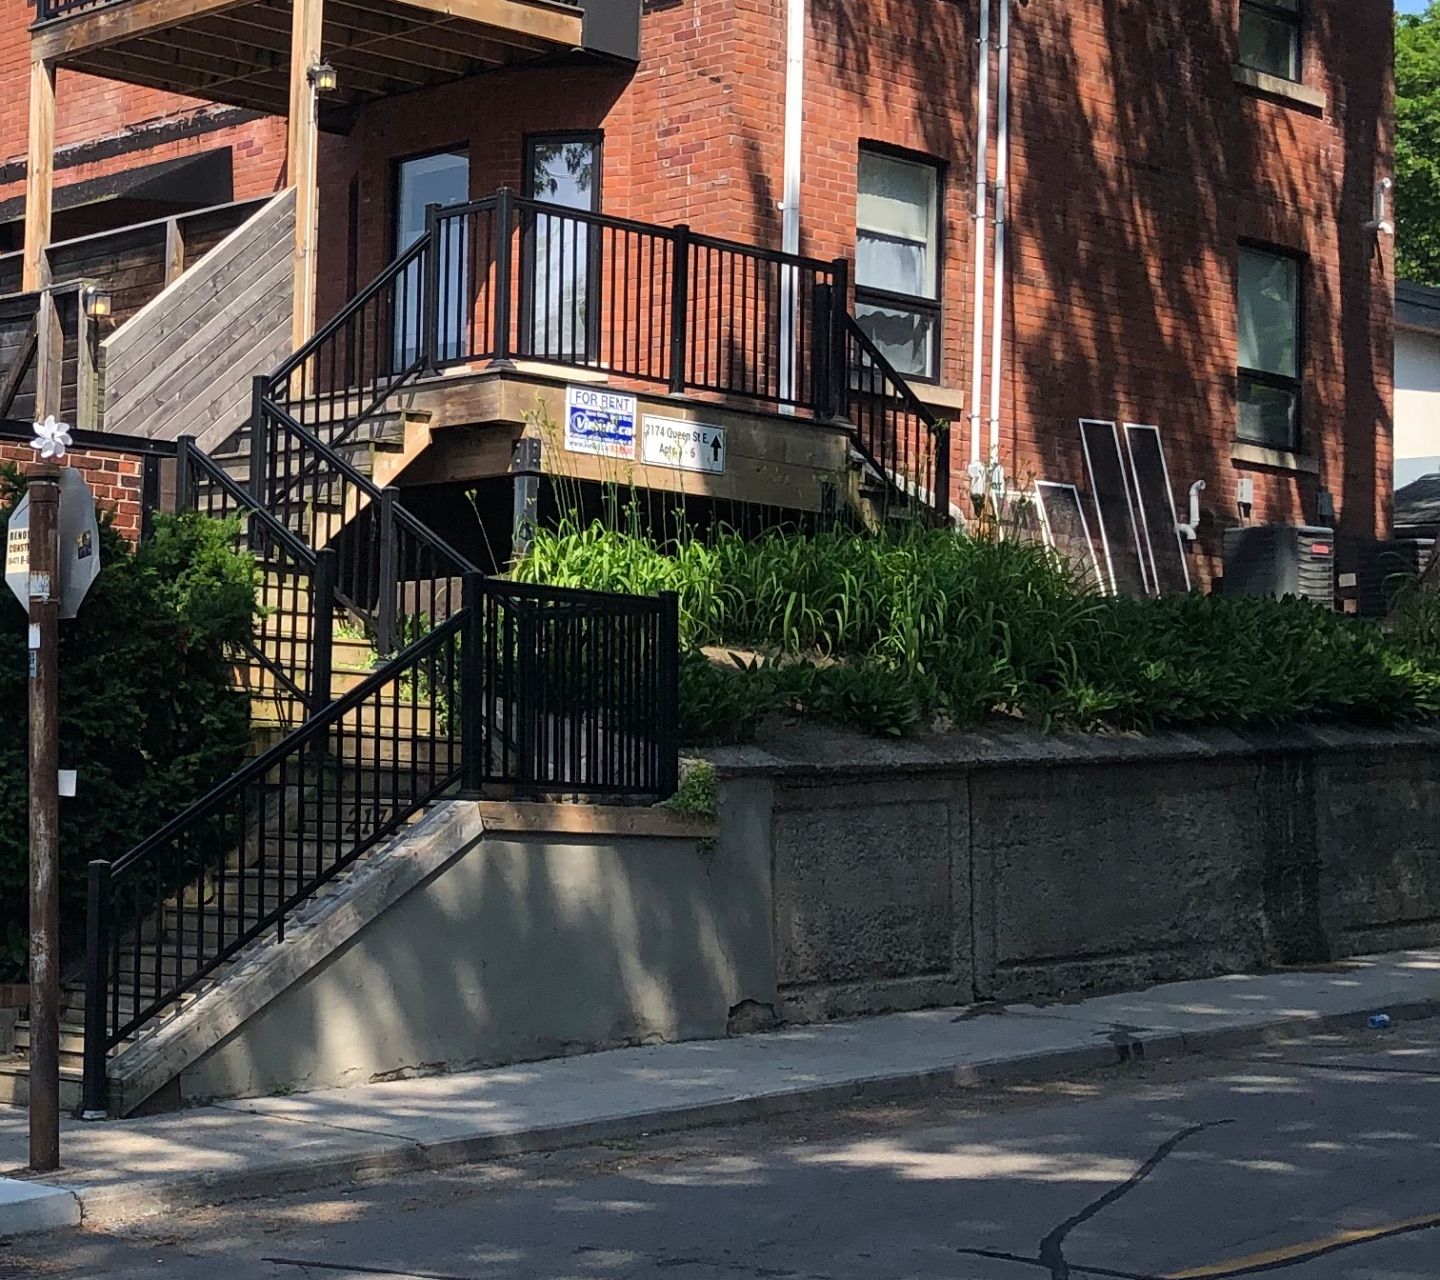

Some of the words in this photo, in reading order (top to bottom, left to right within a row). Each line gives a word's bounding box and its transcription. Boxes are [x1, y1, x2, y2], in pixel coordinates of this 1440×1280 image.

[576, 391, 597, 405] FOR
[602, 396, 630, 410] RENT
[645, 424, 665, 437] 2174
[667, 428, 691, 440] Queen
